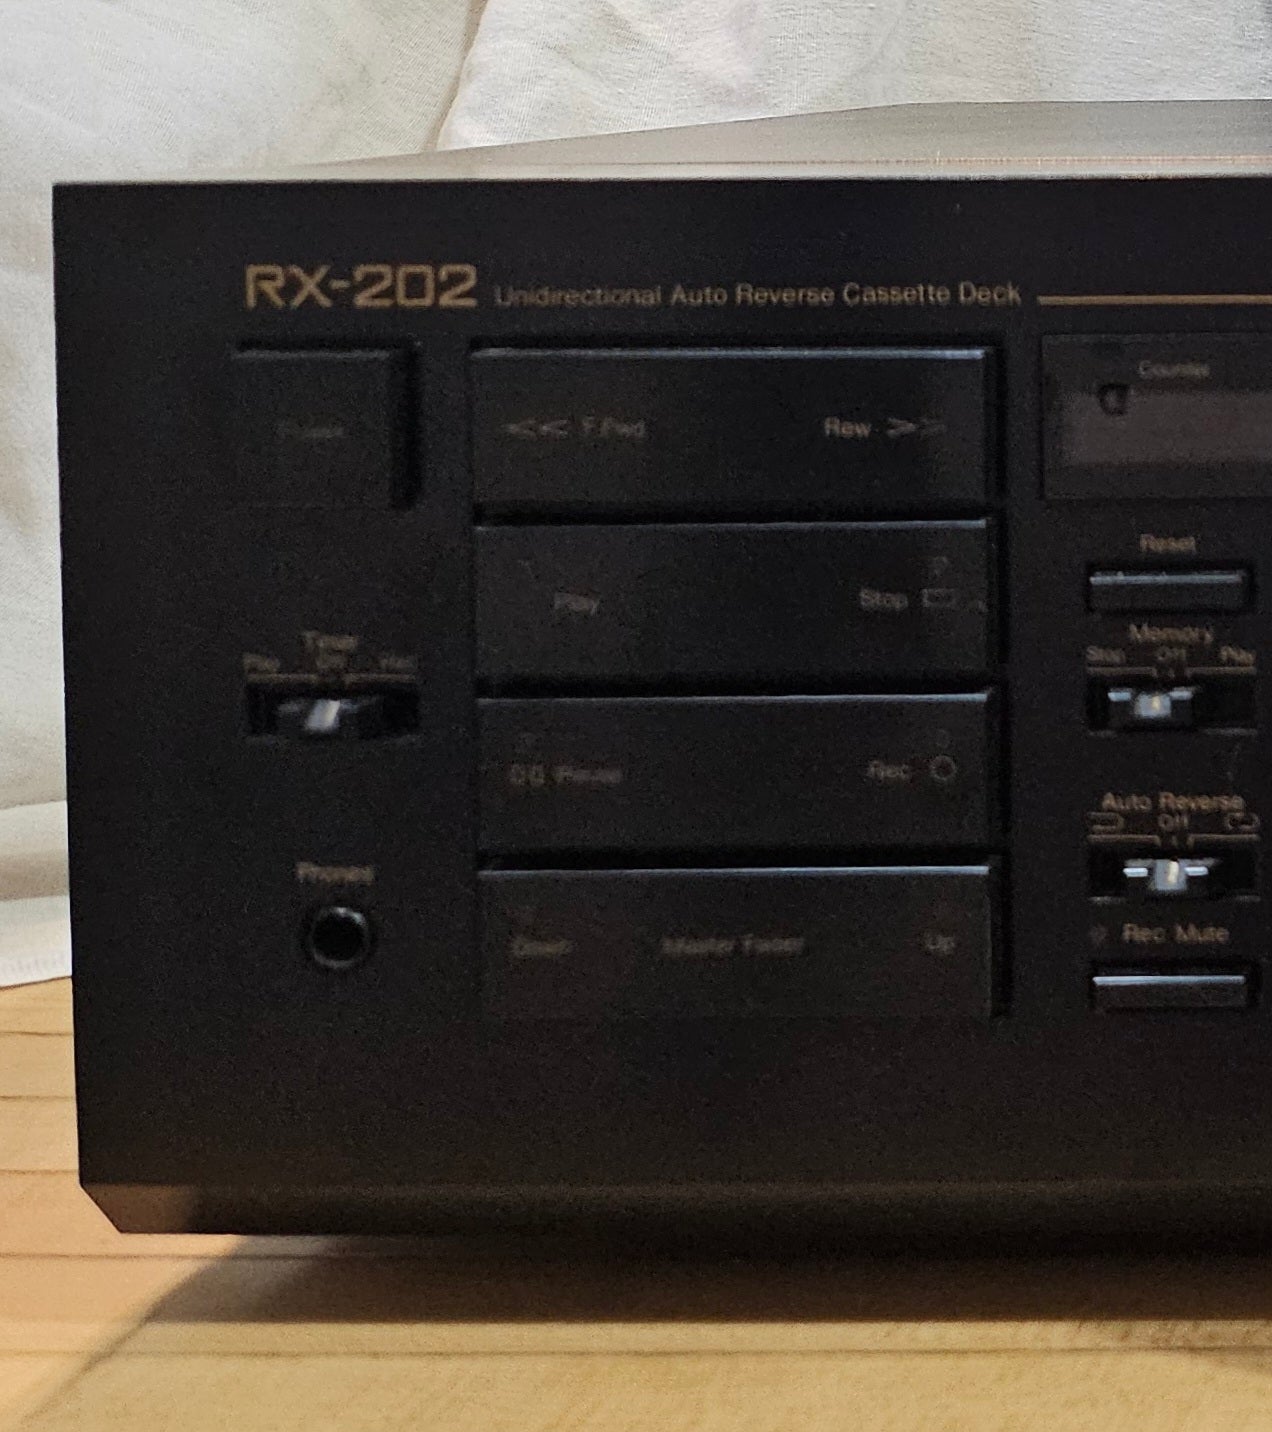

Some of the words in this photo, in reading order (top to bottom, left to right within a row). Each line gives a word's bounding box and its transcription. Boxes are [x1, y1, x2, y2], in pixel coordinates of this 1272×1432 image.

[246, 264, 479, 309] RX-202
[494, 284, 661, 309] Unidirectional
[670, 283, 728, 306] Auto
[735, 282, 835, 306] Reverse
[842, 281, 951, 305] Cassette
[958, 280, 1021, 305] Deck
[825, 416, 871, 438] Rew
[1139, 534, 1196, 553] Reset
[860, 587, 909, 612] Stop
[1129, 623, 1214, 645] Memory
[1102, 792, 1151, 812] Auto
[1159, 791, 1246, 812] Reverse
[1157, 813, 1189, 831] Off
[1122, 923, 1166, 943] Rec
[1174, 923, 1230, 943] Mute
